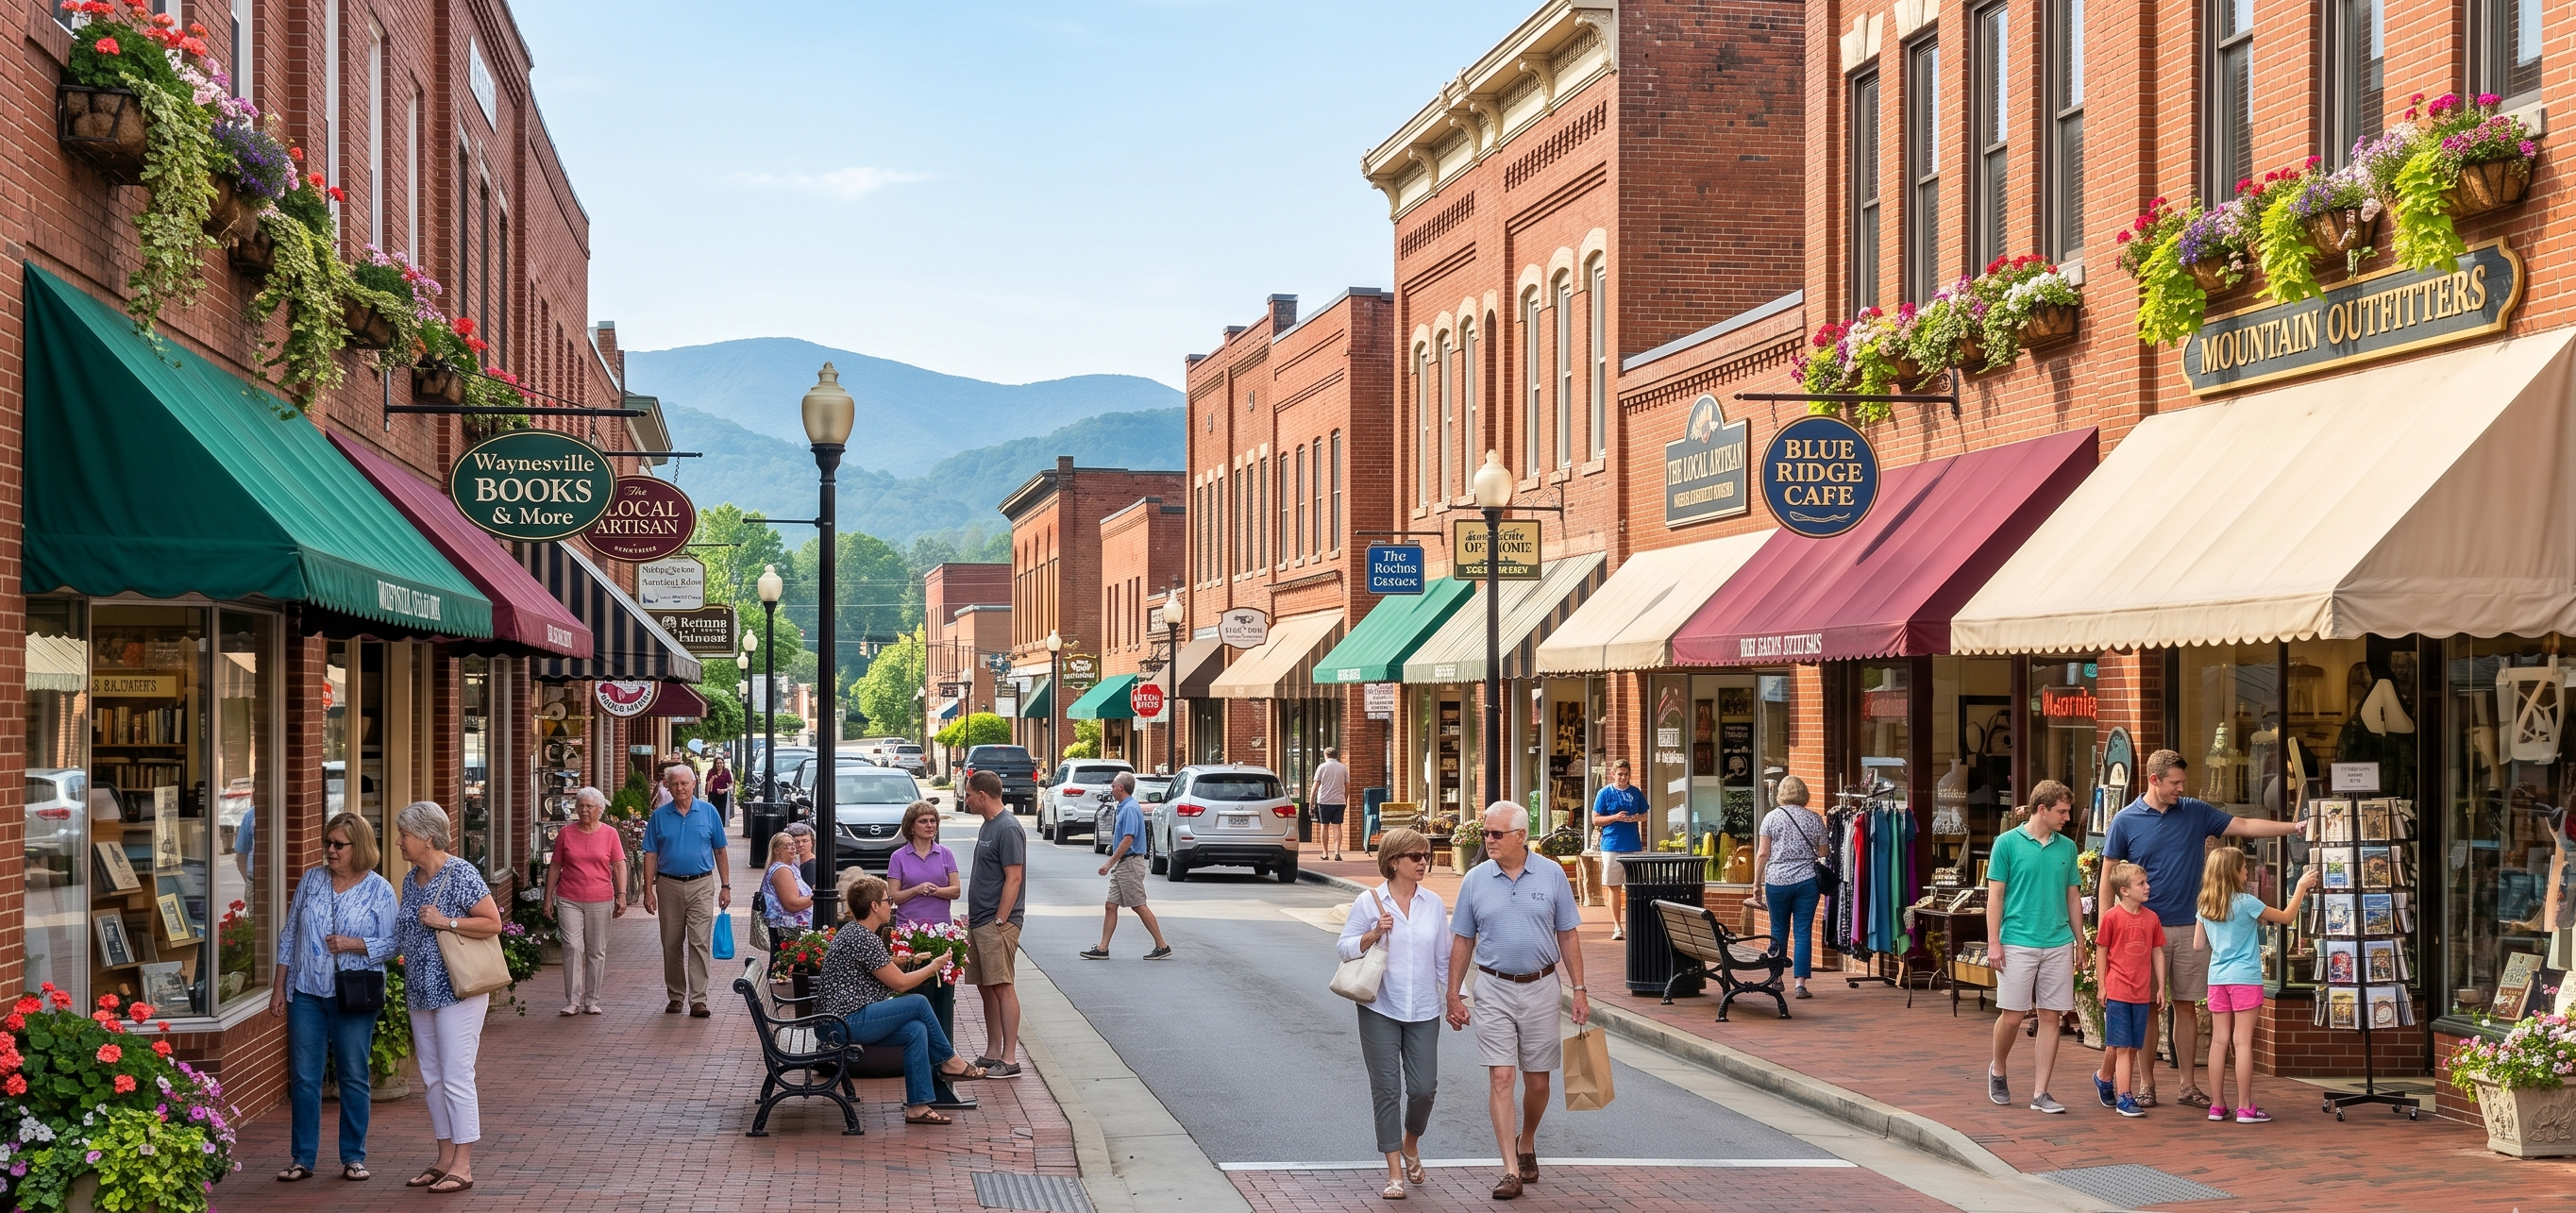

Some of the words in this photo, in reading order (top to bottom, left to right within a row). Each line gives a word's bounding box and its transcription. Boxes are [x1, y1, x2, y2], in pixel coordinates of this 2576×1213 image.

[2199, 308, 2320, 375] MOUNTAIN
[2327, 264, 2486, 345] OUTFITTERS
[1784, 439, 1856, 460] BLUE
[473, 452, 595, 475] Waynesville
[1667, 459, 1682, 486] THE
[1683, 450, 1708, 482] LOCAL
[1709, 441, 1743, 477] ARTISAN
[1776, 462, 1863, 483] RIDGE
[474, 477, 592, 503] BOOKS
[624, 485, 648, 496] The
[1784, 485, 1855, 506] CAFE
[492, 506, 514, 525] &
[519, 507, 574, 525] More
[605, 499, 680, 517] LOCAL
[595, 519, 679, 534] ARTISAN
[1383, 550, 1406, 562] The
